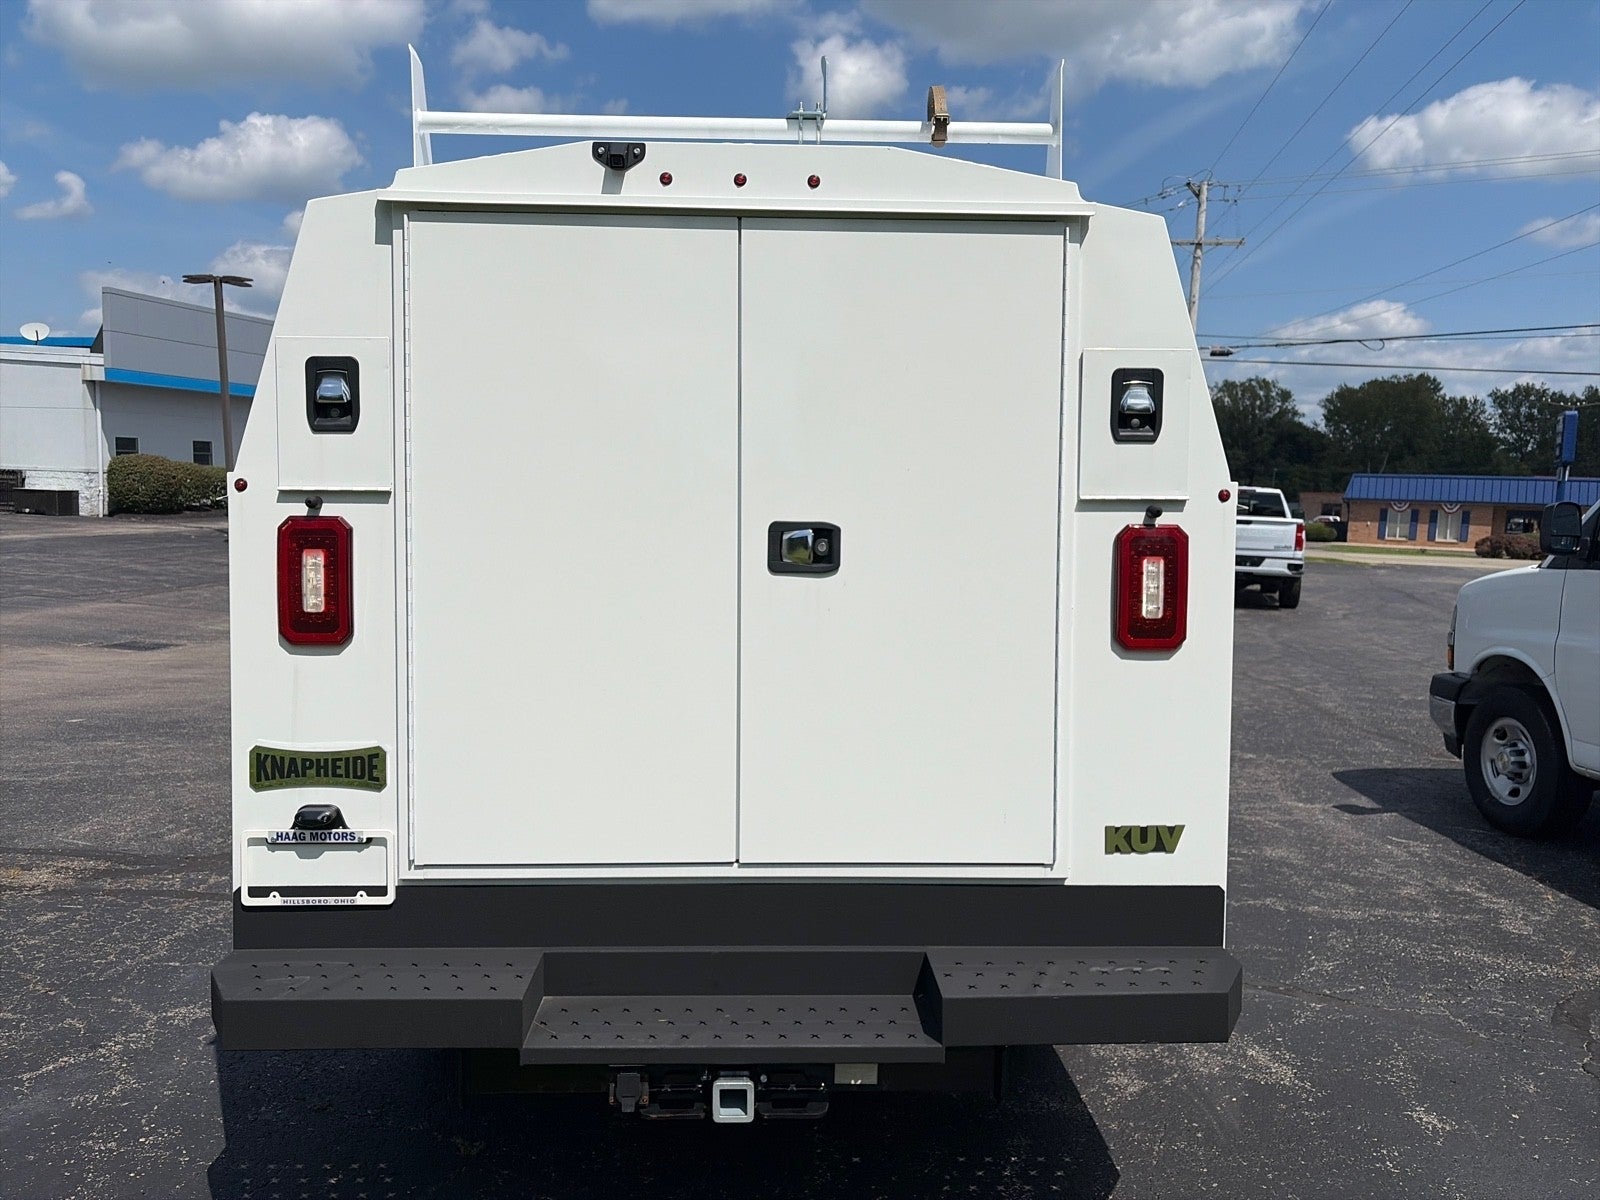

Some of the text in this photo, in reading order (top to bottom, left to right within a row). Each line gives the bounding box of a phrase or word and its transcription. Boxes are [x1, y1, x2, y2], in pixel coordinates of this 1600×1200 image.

[255, 752, 380, 782] KNAPHEIDE
[275, 831, 357, 842] HAAG MOTORS
[1104, 824, 1186, 855] KUV
